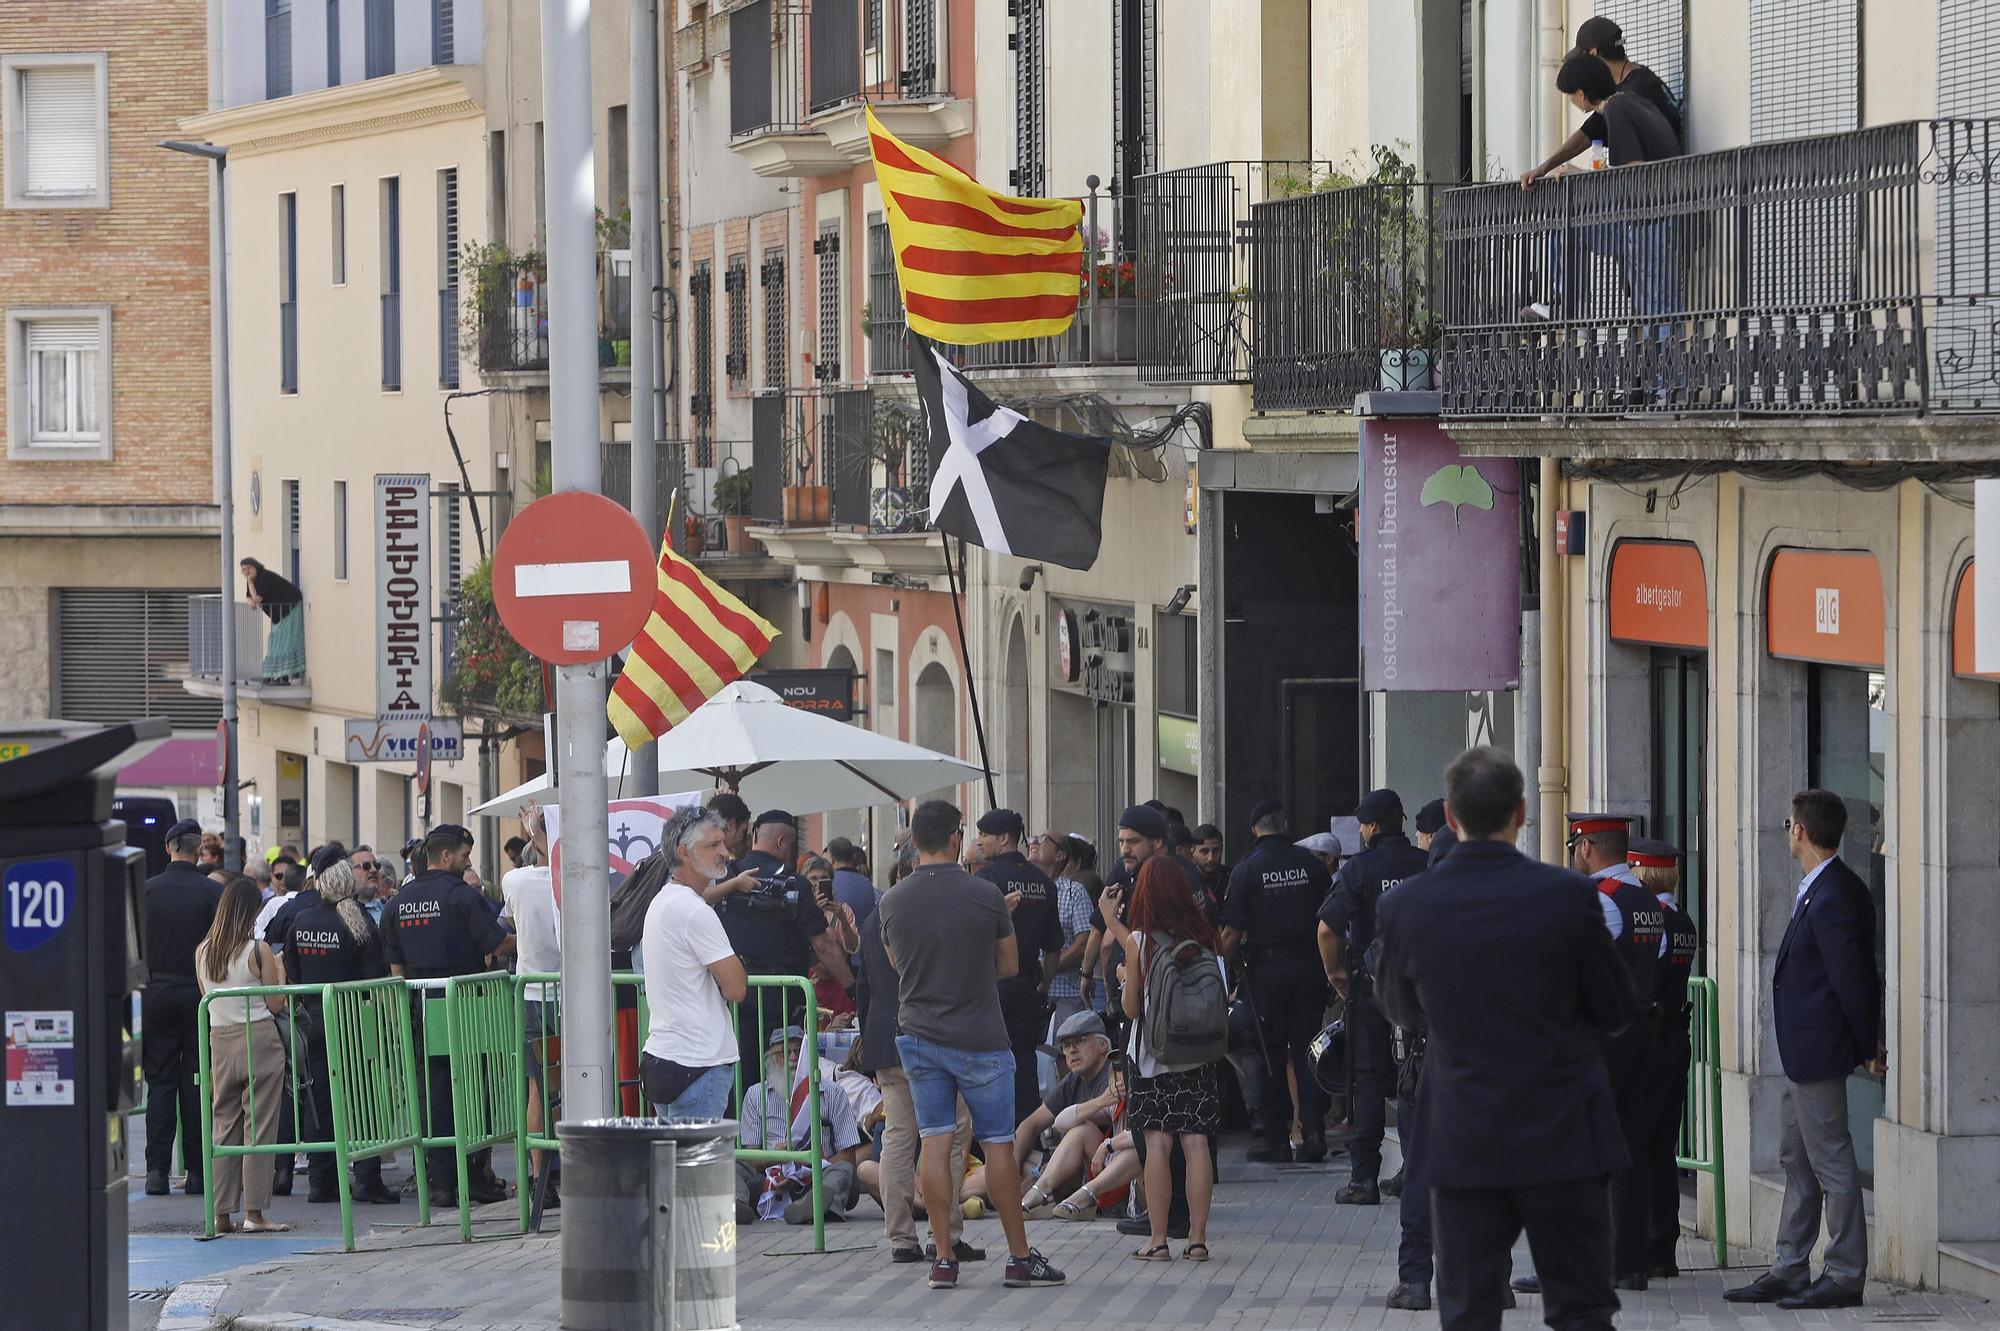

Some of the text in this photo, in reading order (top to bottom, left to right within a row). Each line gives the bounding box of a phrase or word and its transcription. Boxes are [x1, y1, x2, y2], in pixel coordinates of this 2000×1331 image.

[1378, 432, 1404, 681] osteopatia i benestar
[385, 486, 420, 710] PELUQUERIA
[1636, 581, 1682, 612] albertgestor
[784, 687, 816, 696] NOU
[386, 737, 458, 751] VICOR
[1262, 868, 1308, 884] POLICIA
[1007, 881, 1046, 895] POLICIA
[8, 881, 65, 928] 120
[399, 900, 440, 914] POLICIA
[1633, 911, 1664, 925] POLICIA
[296, 930, 339, 943] POLICIA
